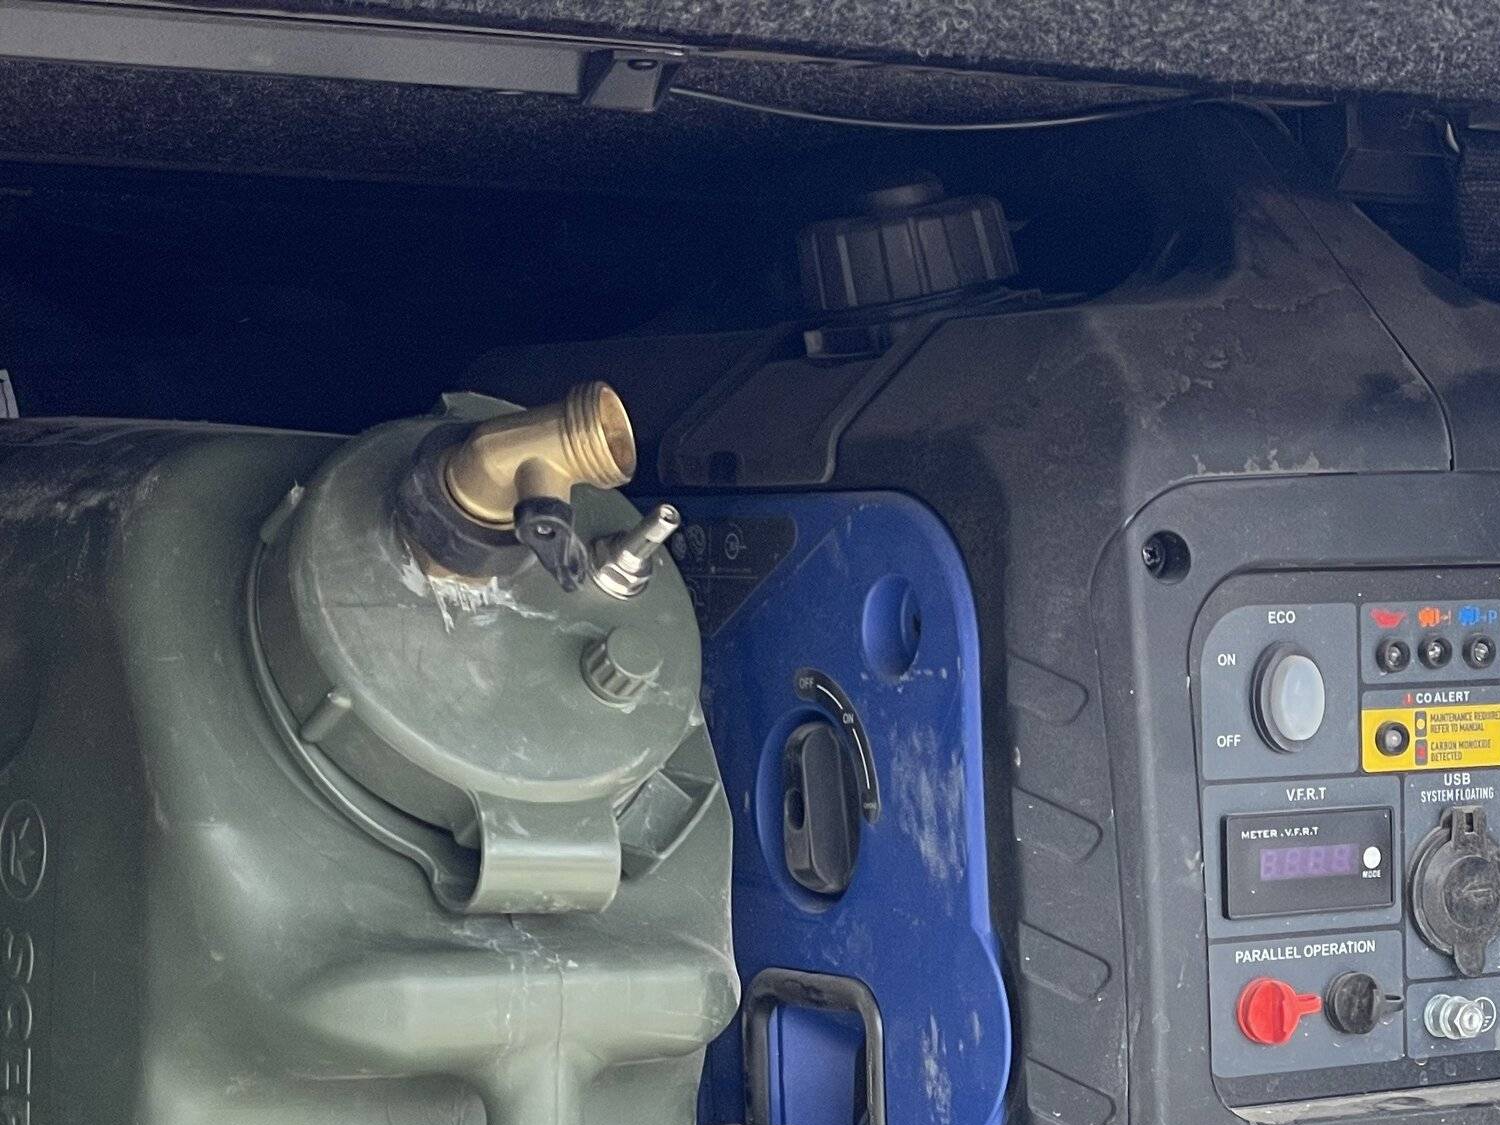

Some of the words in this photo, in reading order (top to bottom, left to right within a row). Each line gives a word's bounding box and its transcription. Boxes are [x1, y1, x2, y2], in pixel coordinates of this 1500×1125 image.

[1267, 610, 1296, 624] ECO
[1217, 653, 1236, 666] ON
[1415, 692, 1432, 704] CO
[1433, 690, 1470, 703] ALERT
[842, 713, 854, 724] ON
[1450, 723, 1459, 732] TO
[1216, 734, 1241, 747] OFF
[1431, 751, 1463, 762] DETECTED
[1444, 772, 1471, 786] USB
[1286, 787, 1327, 801] V.F.R.T
[1420, 789, 1454, 803] SYSTEM
[1455, 786, 1494, 801] FLOATING
[1241, 829, 1278, 840] METER
[1235, 947, 1302, 964] PARALLEL
[1303, 940, 1376, 958] OPERATION
